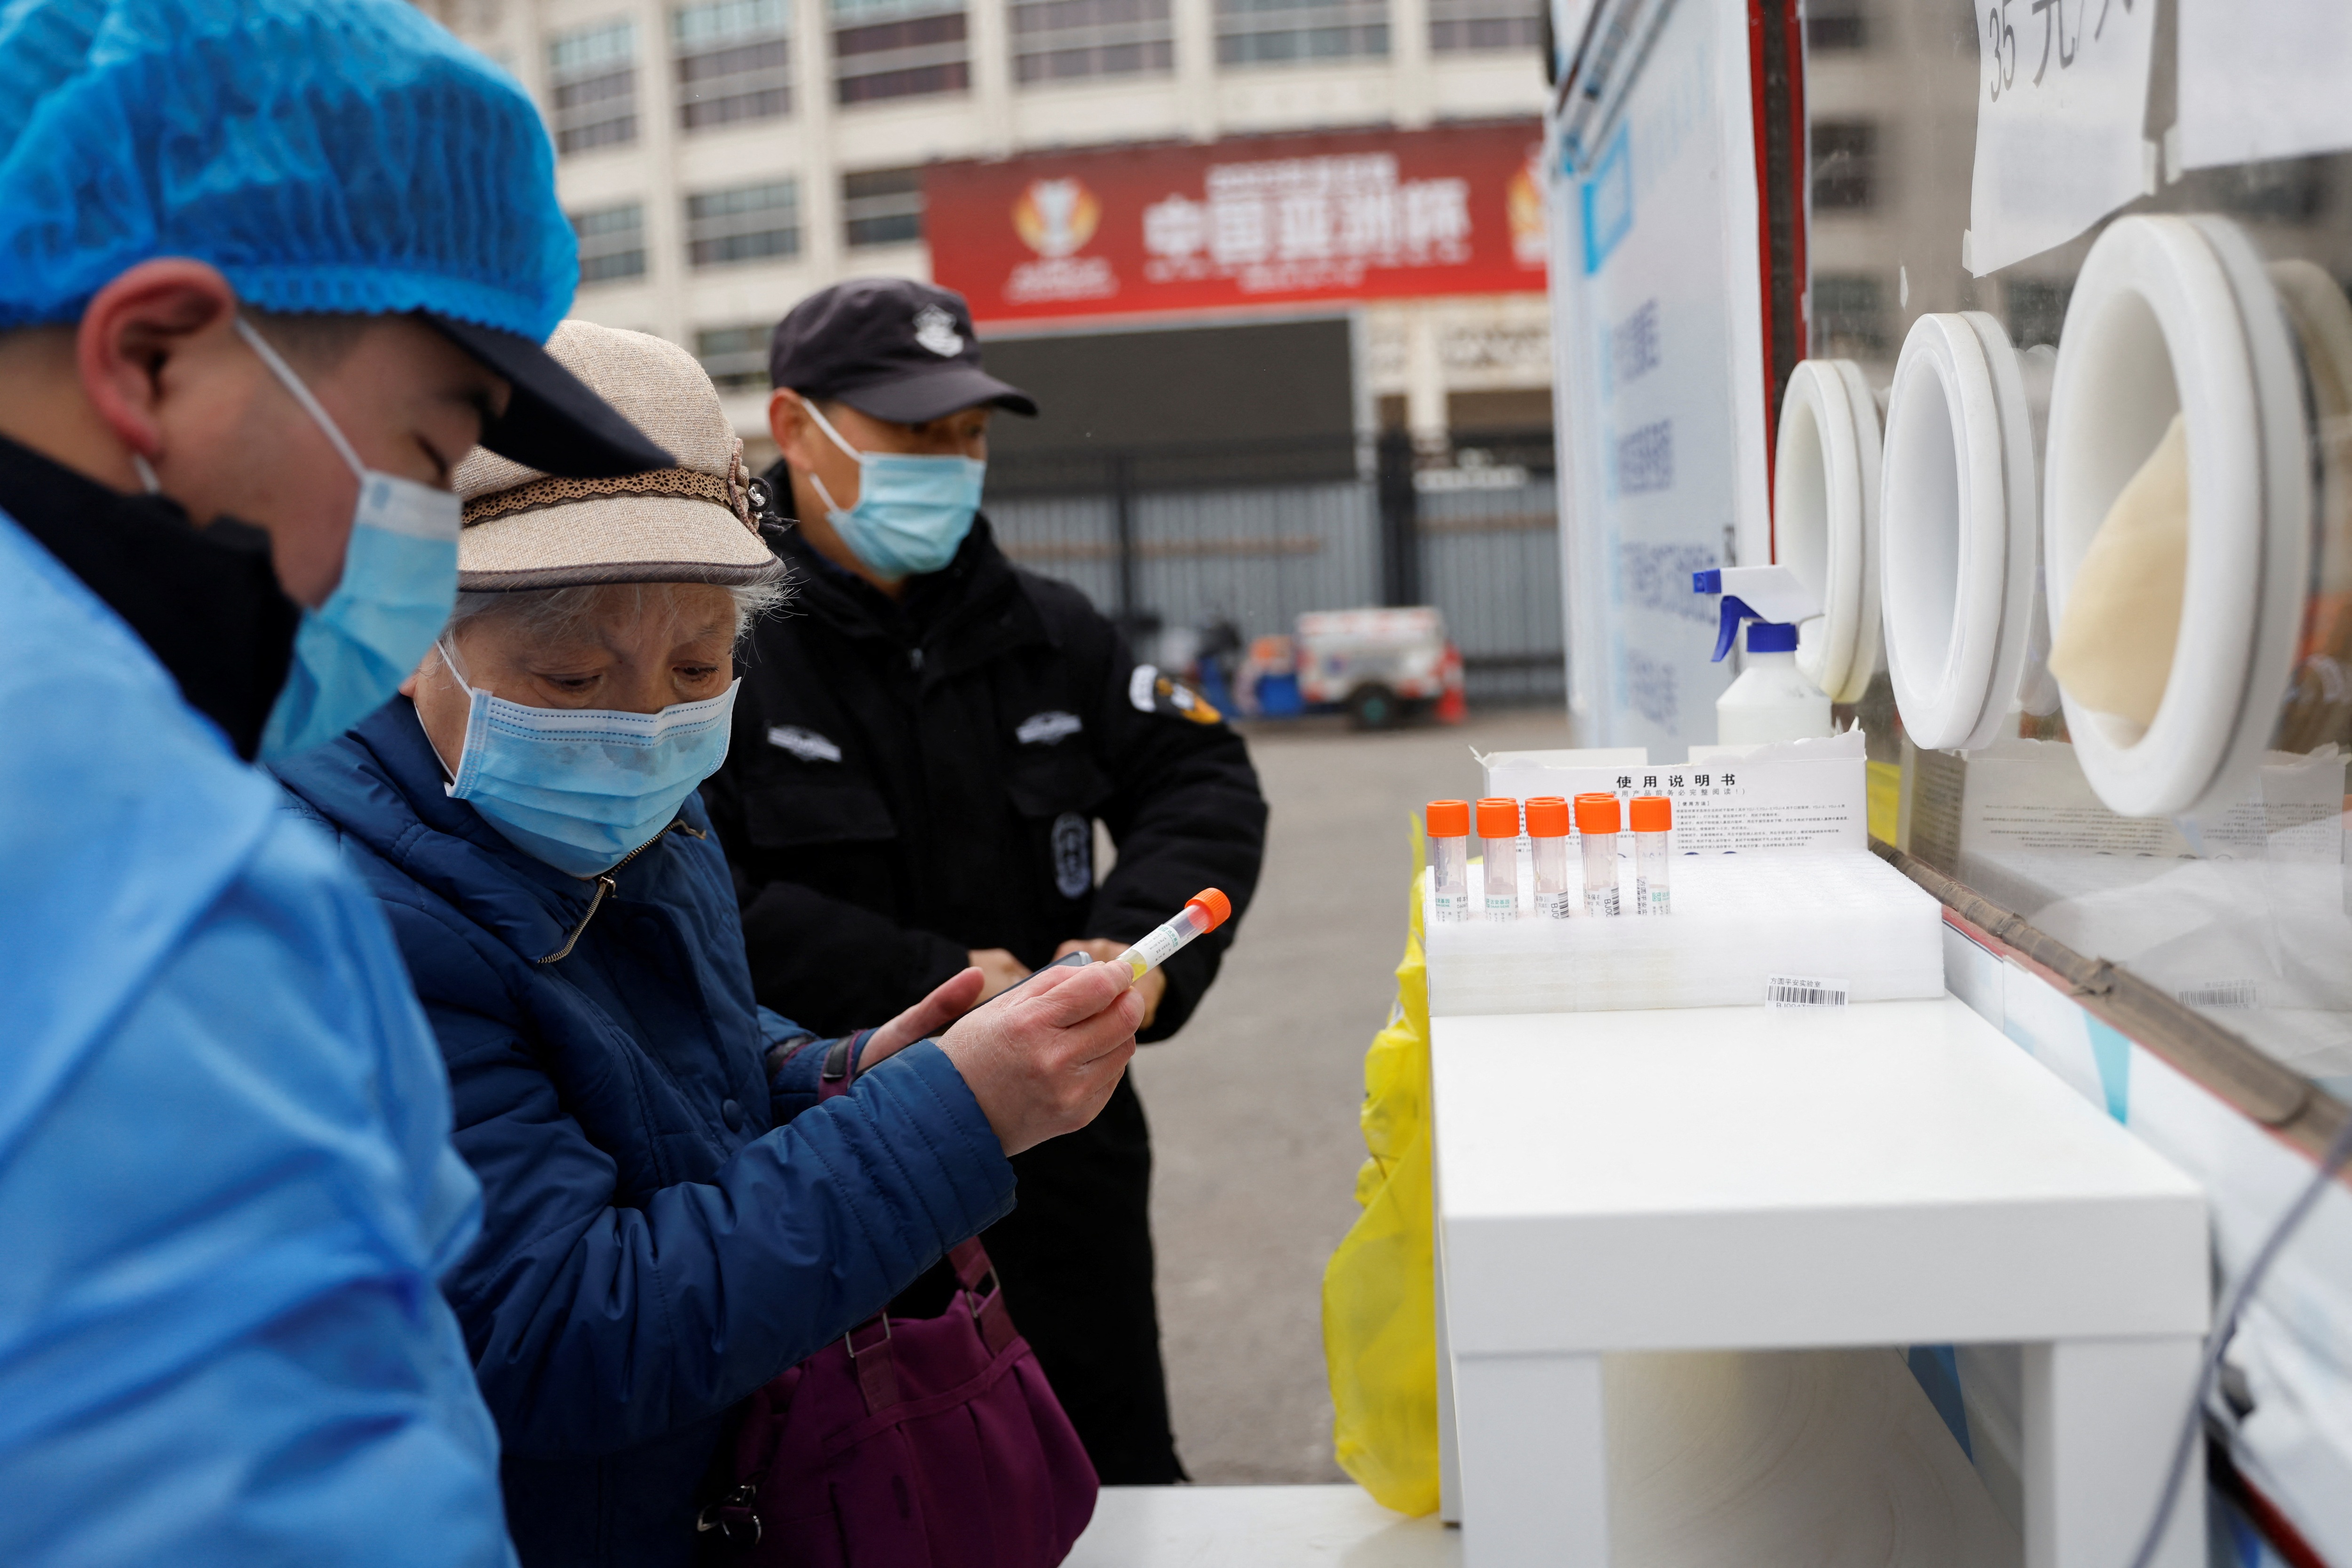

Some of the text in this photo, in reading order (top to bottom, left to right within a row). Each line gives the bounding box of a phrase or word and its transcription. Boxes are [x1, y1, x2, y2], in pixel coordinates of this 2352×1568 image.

[1616, 774, 1736, 788] 使用说明书
[1770, 977, 1821, 988] 方圆平安实验室
